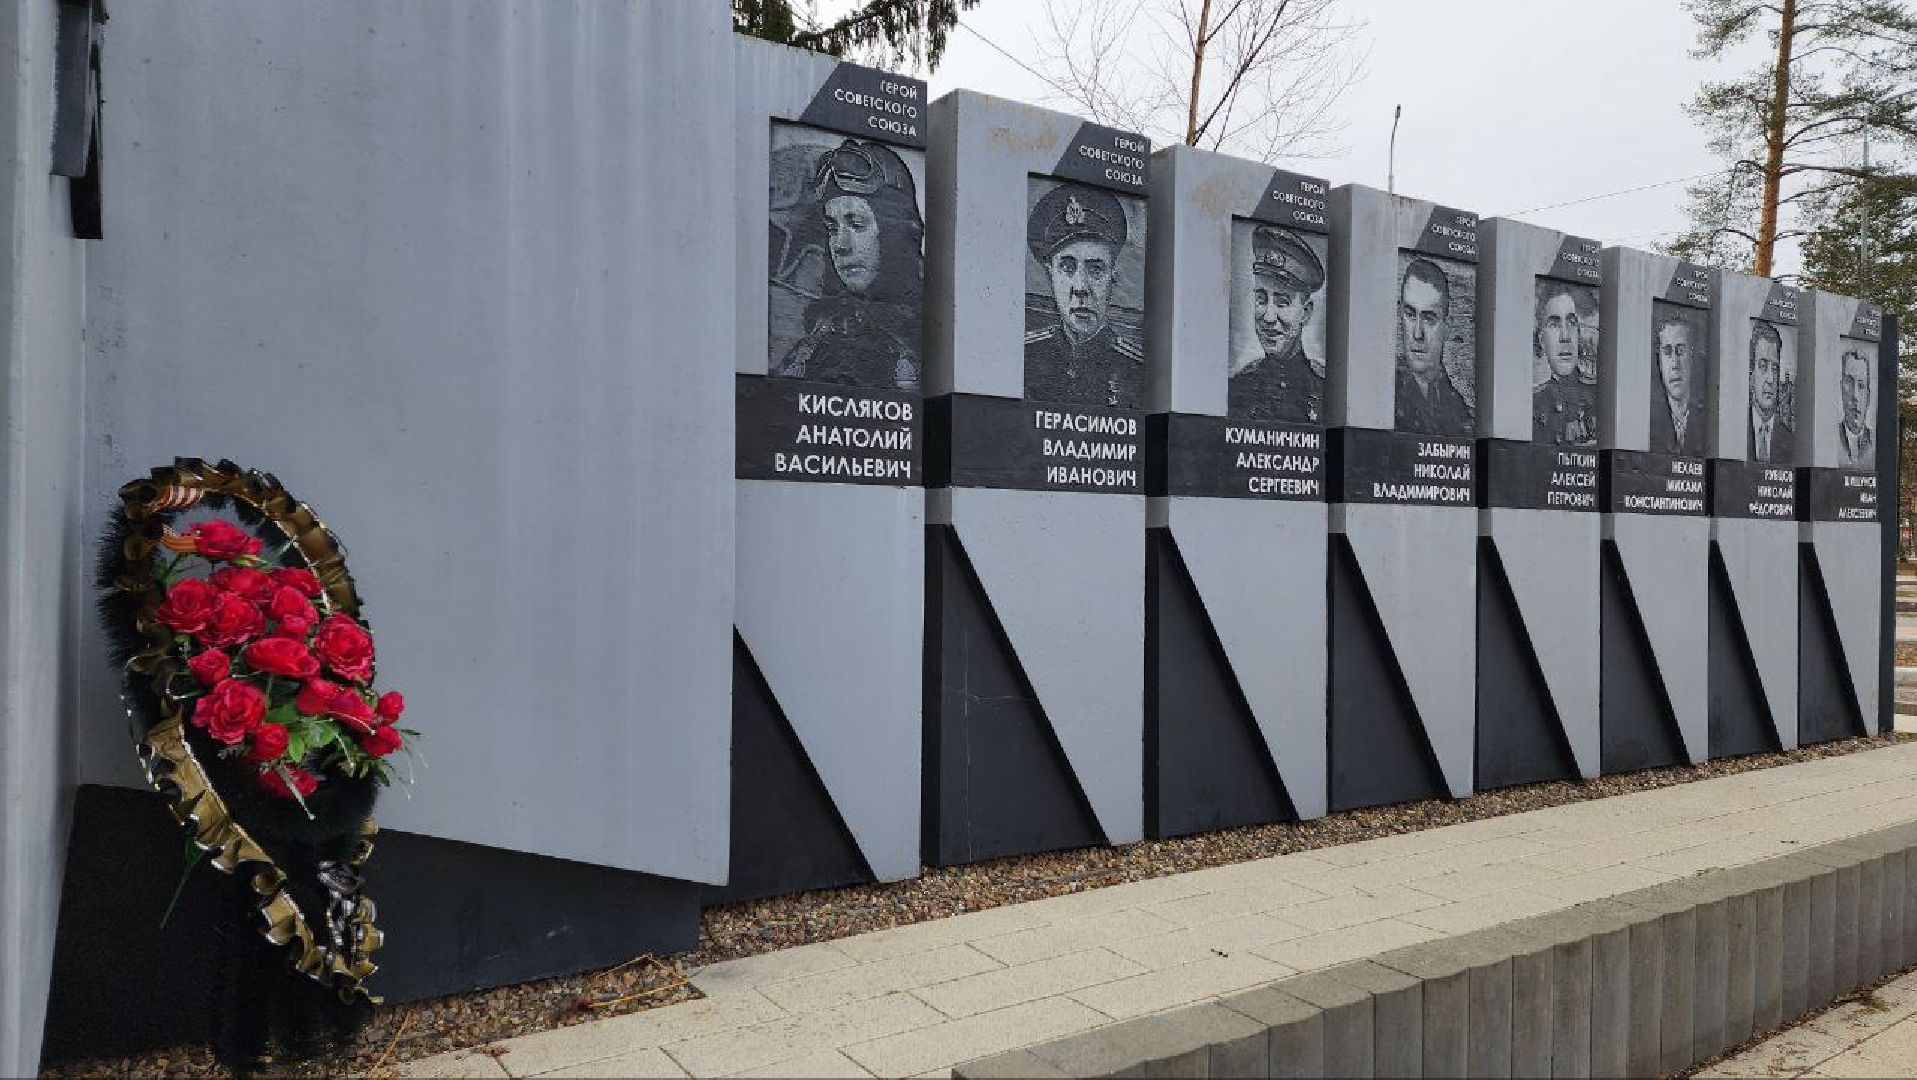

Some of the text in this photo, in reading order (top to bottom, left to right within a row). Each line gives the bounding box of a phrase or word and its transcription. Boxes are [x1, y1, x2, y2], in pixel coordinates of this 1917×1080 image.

[880, 80, 918, 99] ГЕРОЙ
[834, 89, 918, 119] СОВЕТСКОГО
[868, 116, 918, 137] СОЮЗА
[1114, 137, 1145, 152] ГЕРОЙ
[1079, 145, 1145, 169] СОВЕТСКОГО
[1105, 169, 1143, 186] СОЮЗА
[1272, 190, 1325, 210] СОВЕТСКОГО
[1293, 211, 1325, 225] СОЮЗА
[798, 393, 913, 421] КИСЛЯКОВ
[1035, 410, 1137, 435] ГЕРАСИМОВ
[795, 424, 913, 450] АНАТОЛИЙ
[1225, 427, 1320, 450] КУМАНИЧКИН
[1042, 438, 1137, 461] ВЛАДИМИР
[1417, 442, 1471, 460] ЗАБЫРИН
[774, 452, 912, 479] ВАСИЛЬЕВИЧ
[1236, 452, 1320, 474] АЛЕКСАНДР
[1414, 463, 1471, 481] НИКОЛАЙ
[1671, 461, 1703, 475] НЕХАЕВ
[1047, 465, 1137, 487] ИВАНОВИЧ
[1248, 476, 1320, 496] СЕРГЕЕВИЧ
[1550, 471, 1596, 487] АЛЕКСЕЙ
[1665, 479, 1703, 493] МИХАИЛ
[1373, 482, 1470, 502] ВЛАДИМИРОВИЧ
[1547, 491, 1595, 507] ПЕТРОВИЧ
[1757, 485, 1793, 499] НИКОЛАЙ
[1624, 494, 1703, 511] КОНСТАНТИНОВИЧ
